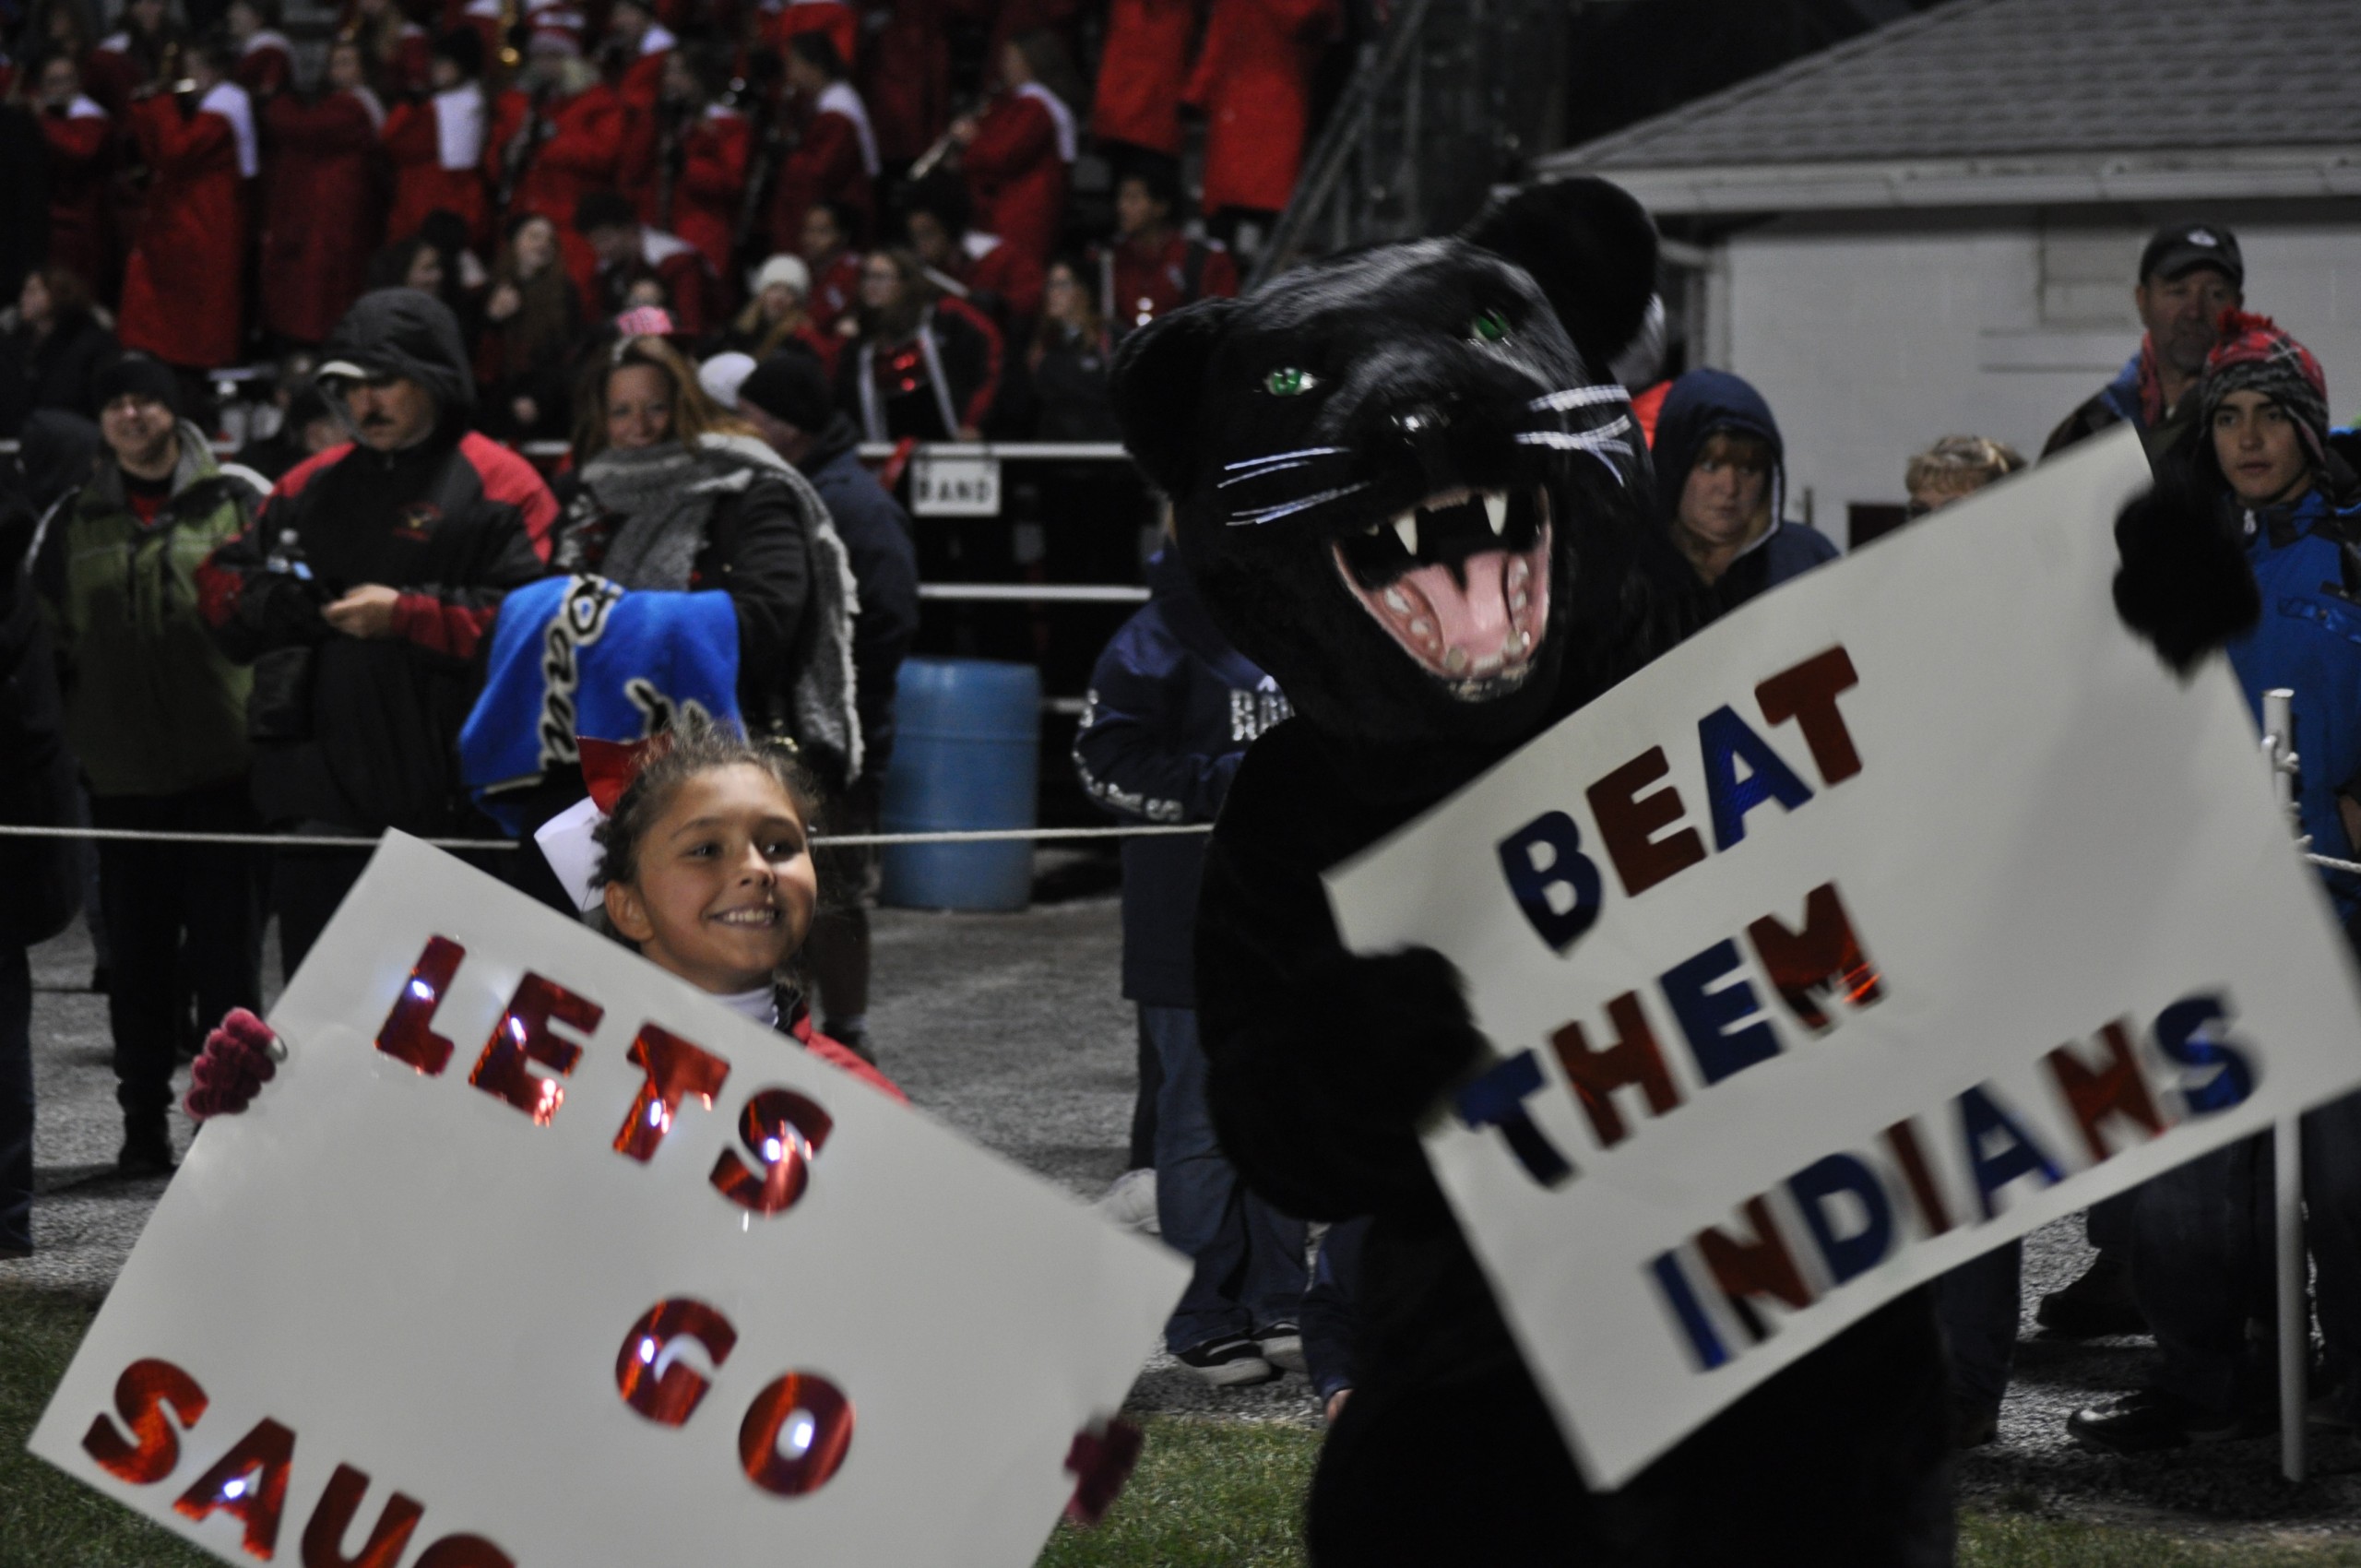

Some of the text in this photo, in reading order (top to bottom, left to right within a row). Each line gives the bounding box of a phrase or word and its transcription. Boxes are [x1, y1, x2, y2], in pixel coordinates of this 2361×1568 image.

[1497, 644, 1864, 956] BEAT
[374, 933, 834, 1218] LETS
[1455, 881, 1885, 1194] THEM
[1642, 988, 2265, 1374] INDIANS
[615, 1296, 856, 1499] GO
